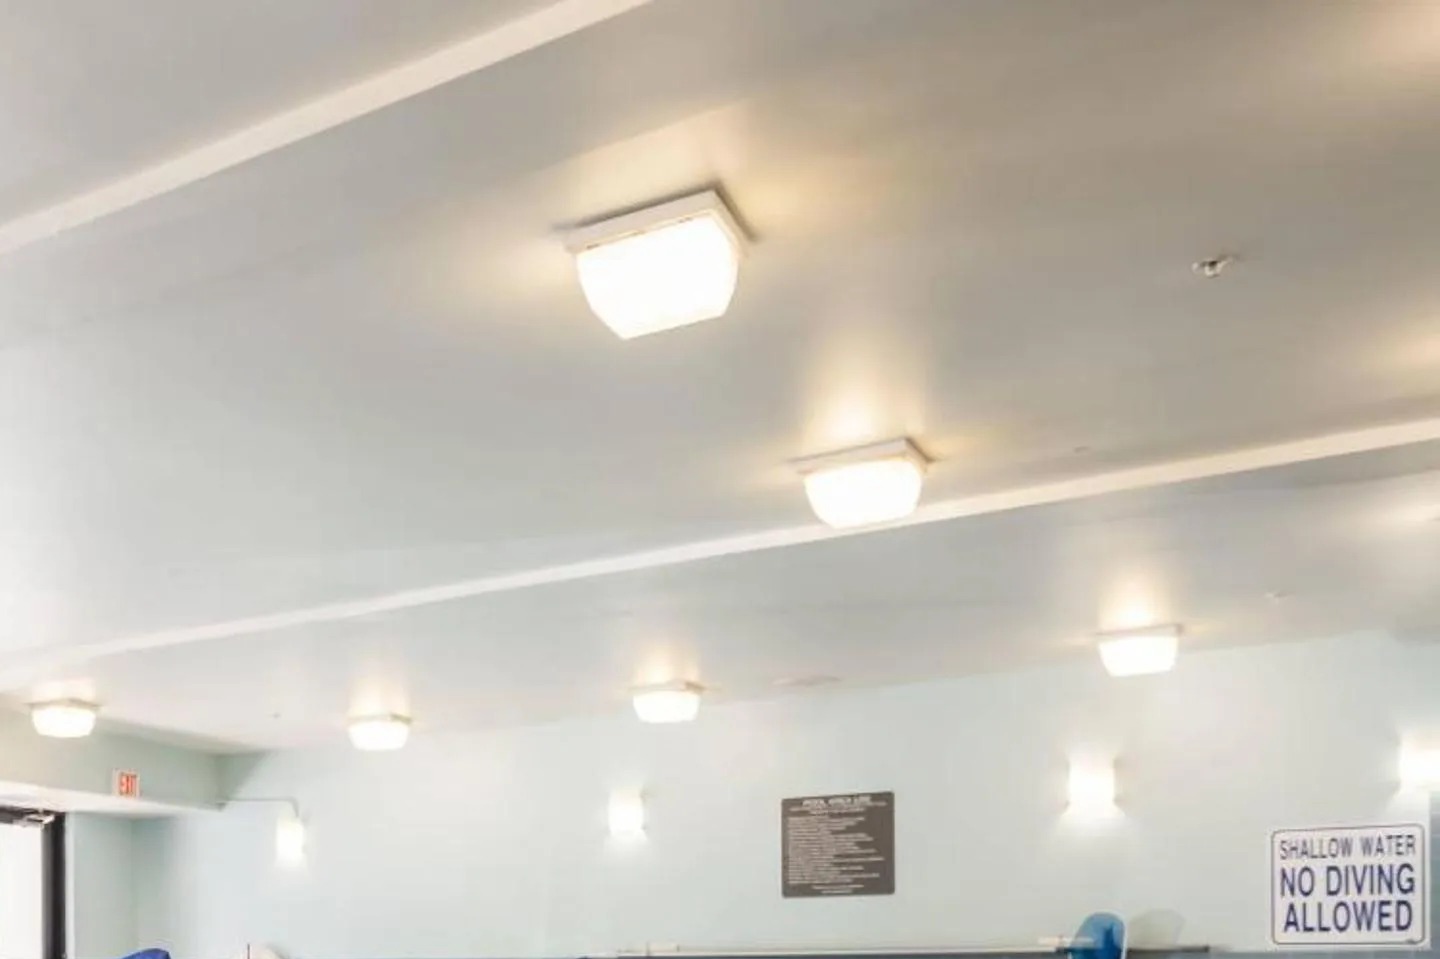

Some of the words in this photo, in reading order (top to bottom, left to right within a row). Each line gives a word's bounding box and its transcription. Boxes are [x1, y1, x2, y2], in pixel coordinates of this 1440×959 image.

[1280, 837, 1353, 860] SHALLOW
[1361, 834, 1416, 857] WATER
[1280, 867, 1315, 897] NO
[1326, 863, 1416, 896] DIVING
[1284, 900, 1413, 932] ALLOWED
